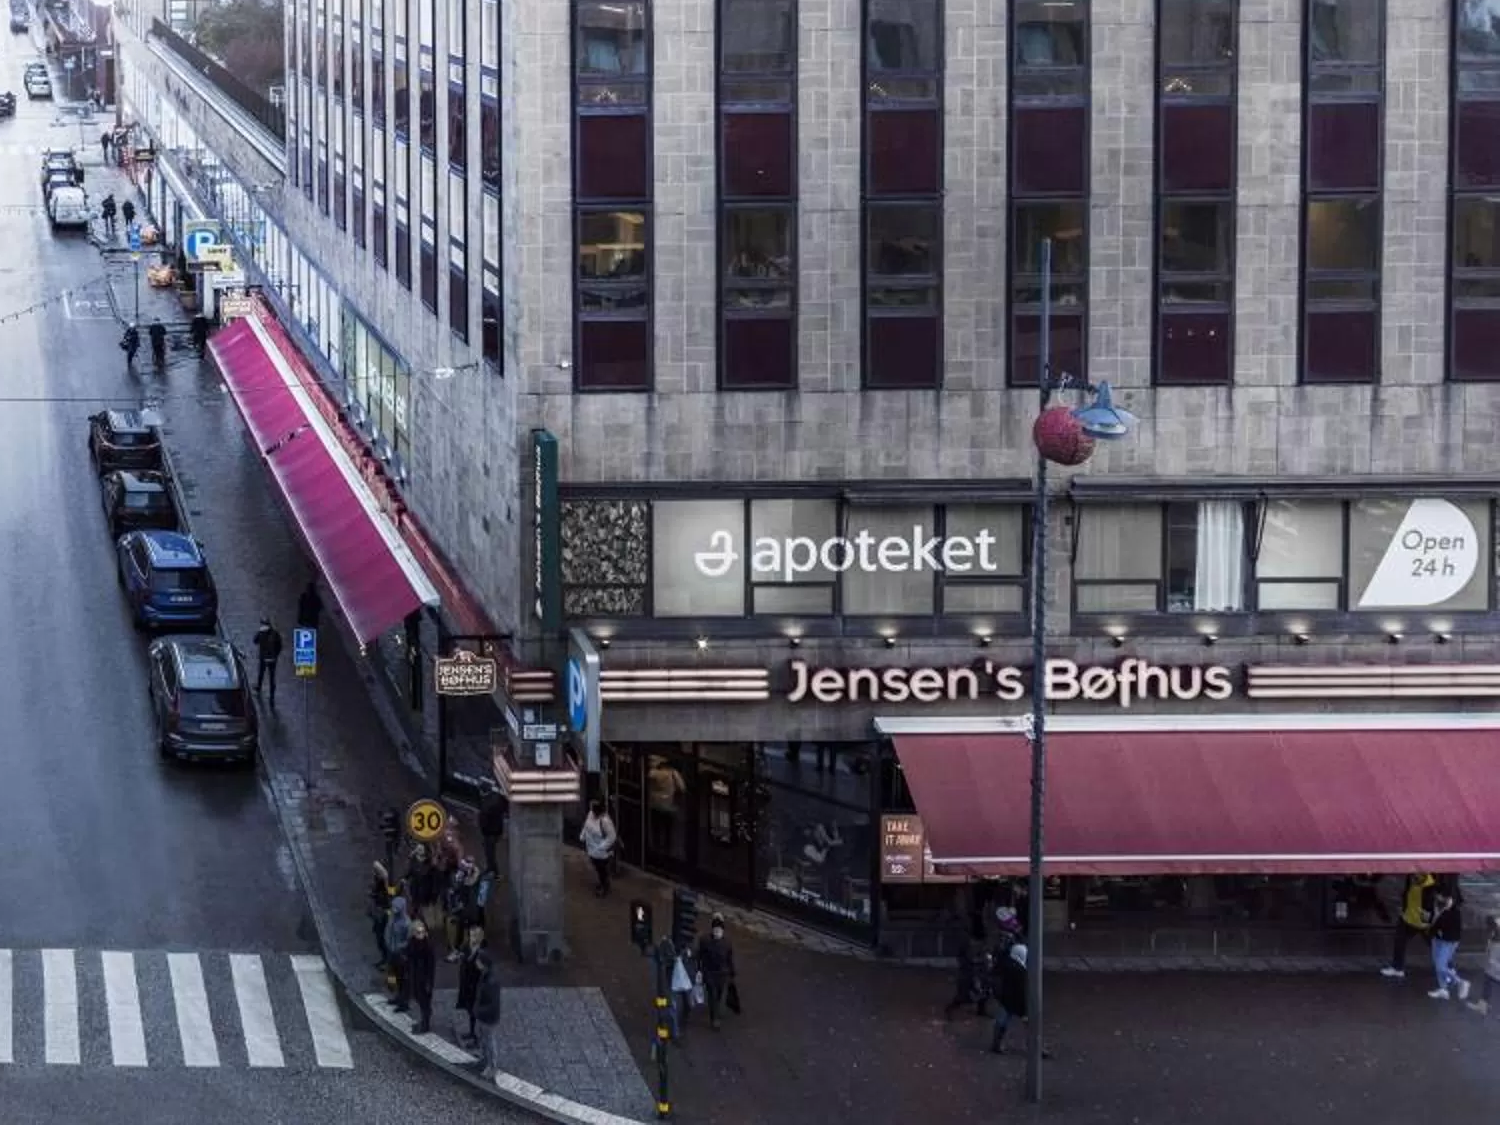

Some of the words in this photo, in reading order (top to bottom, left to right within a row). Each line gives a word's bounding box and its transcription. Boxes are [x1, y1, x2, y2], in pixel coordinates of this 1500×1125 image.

[751, 525, 998, 582] apoteket
[1401, 529, 1466, 556] Open
[1411, 550, 1439, 576] 24
[1441, 550, 1456, 576] h
[787, 660, 1025, 702] Jensen's
[1044, 658, 1234, 708] Bøfhus
[413, 811, 441, 832] 30
